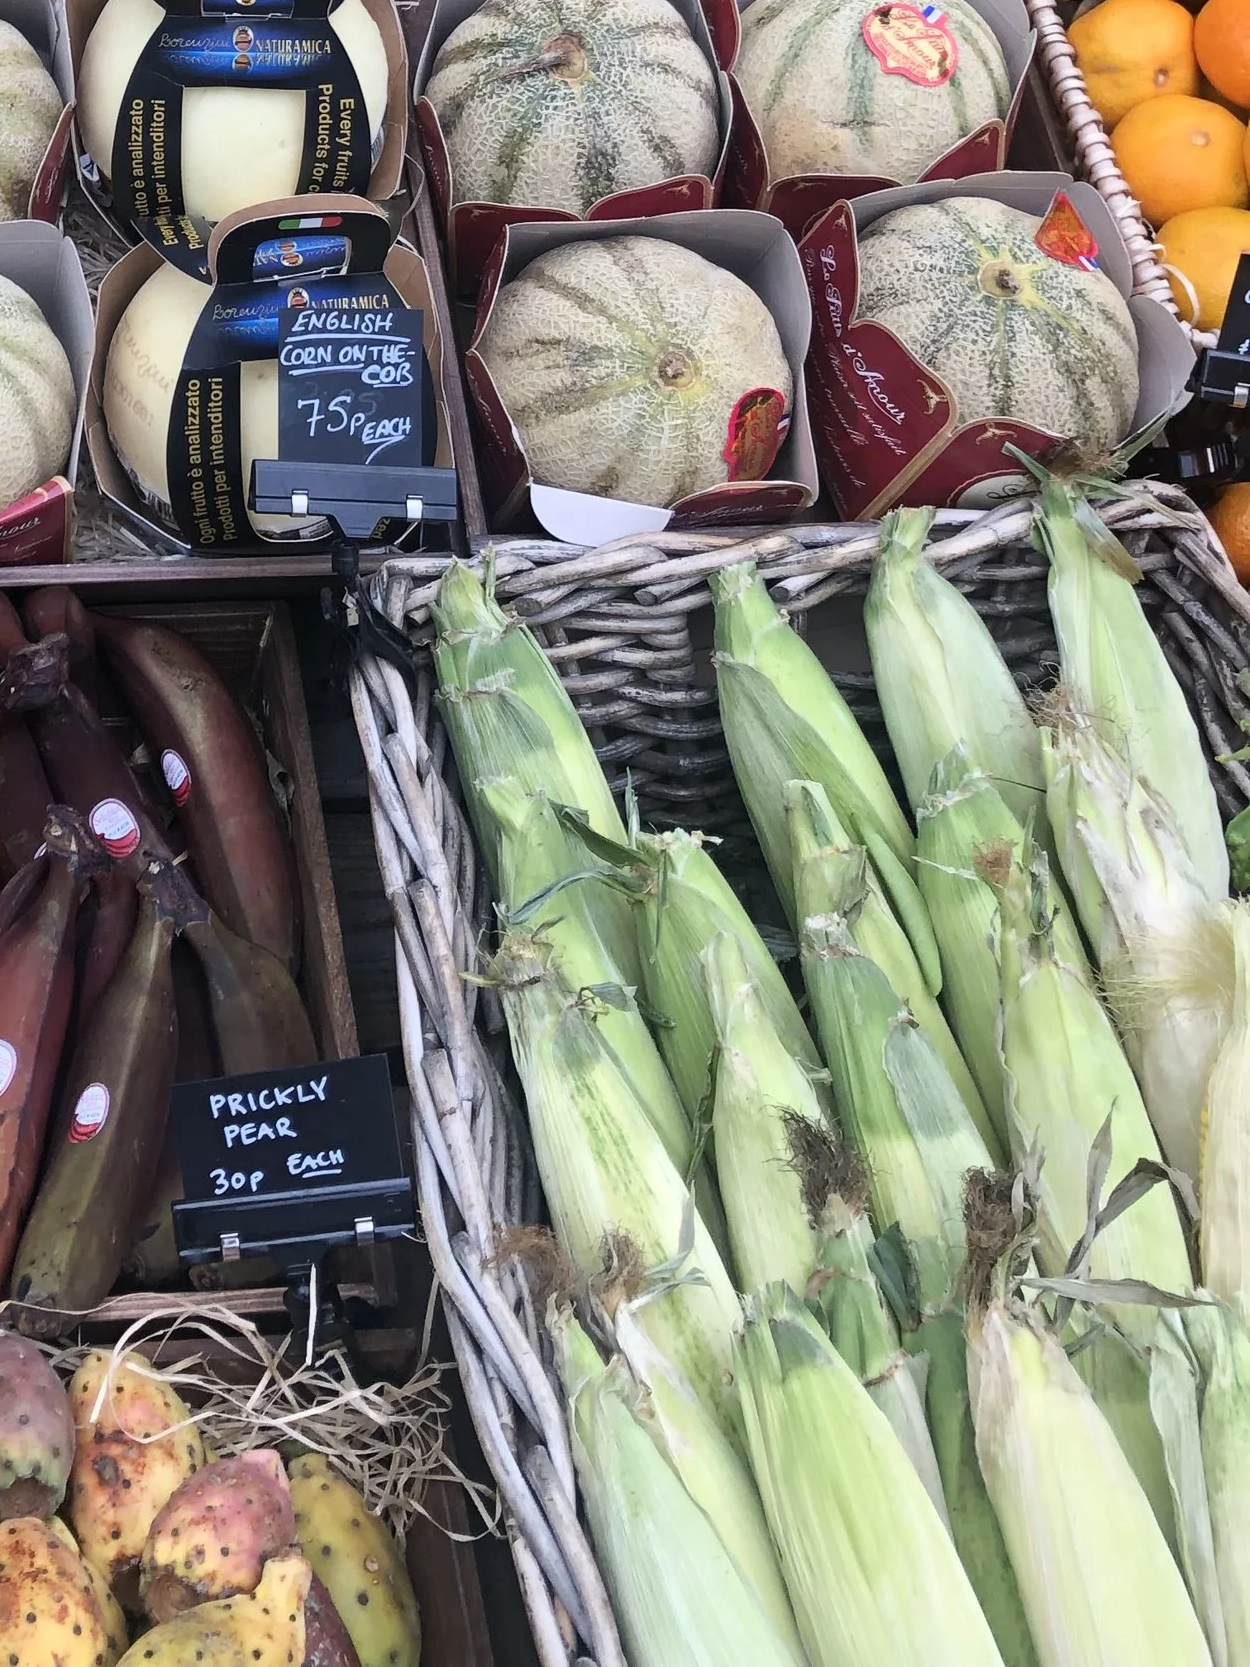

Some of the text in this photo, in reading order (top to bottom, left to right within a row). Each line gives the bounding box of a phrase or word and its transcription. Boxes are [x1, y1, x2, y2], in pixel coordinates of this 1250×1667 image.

[256, 38, 331, 55] NATURAMICA
[128, 99, 144, 178] analizzato
[151, 99, 166, 179] intenditori
[312, 84, 333, 183] Products for
[332, 98, 355, 188] Every fruits
[292, 310, 393, 333] ENGLISH
[280, 345, 332, 366] CORN
[361, 364, 413, 384] COB
[185, 379, 202, 465] analizzato
[208, 377, 225, 466] intenditori
[362, 416, 411, 444] EACH
[214, 470, 232, 493] per
[209, 1076, 328, 1119] PRICKLY
[223, 1117, 298, 1148] PEAR
[209, 1149, 345, 1196] 30p EACH
